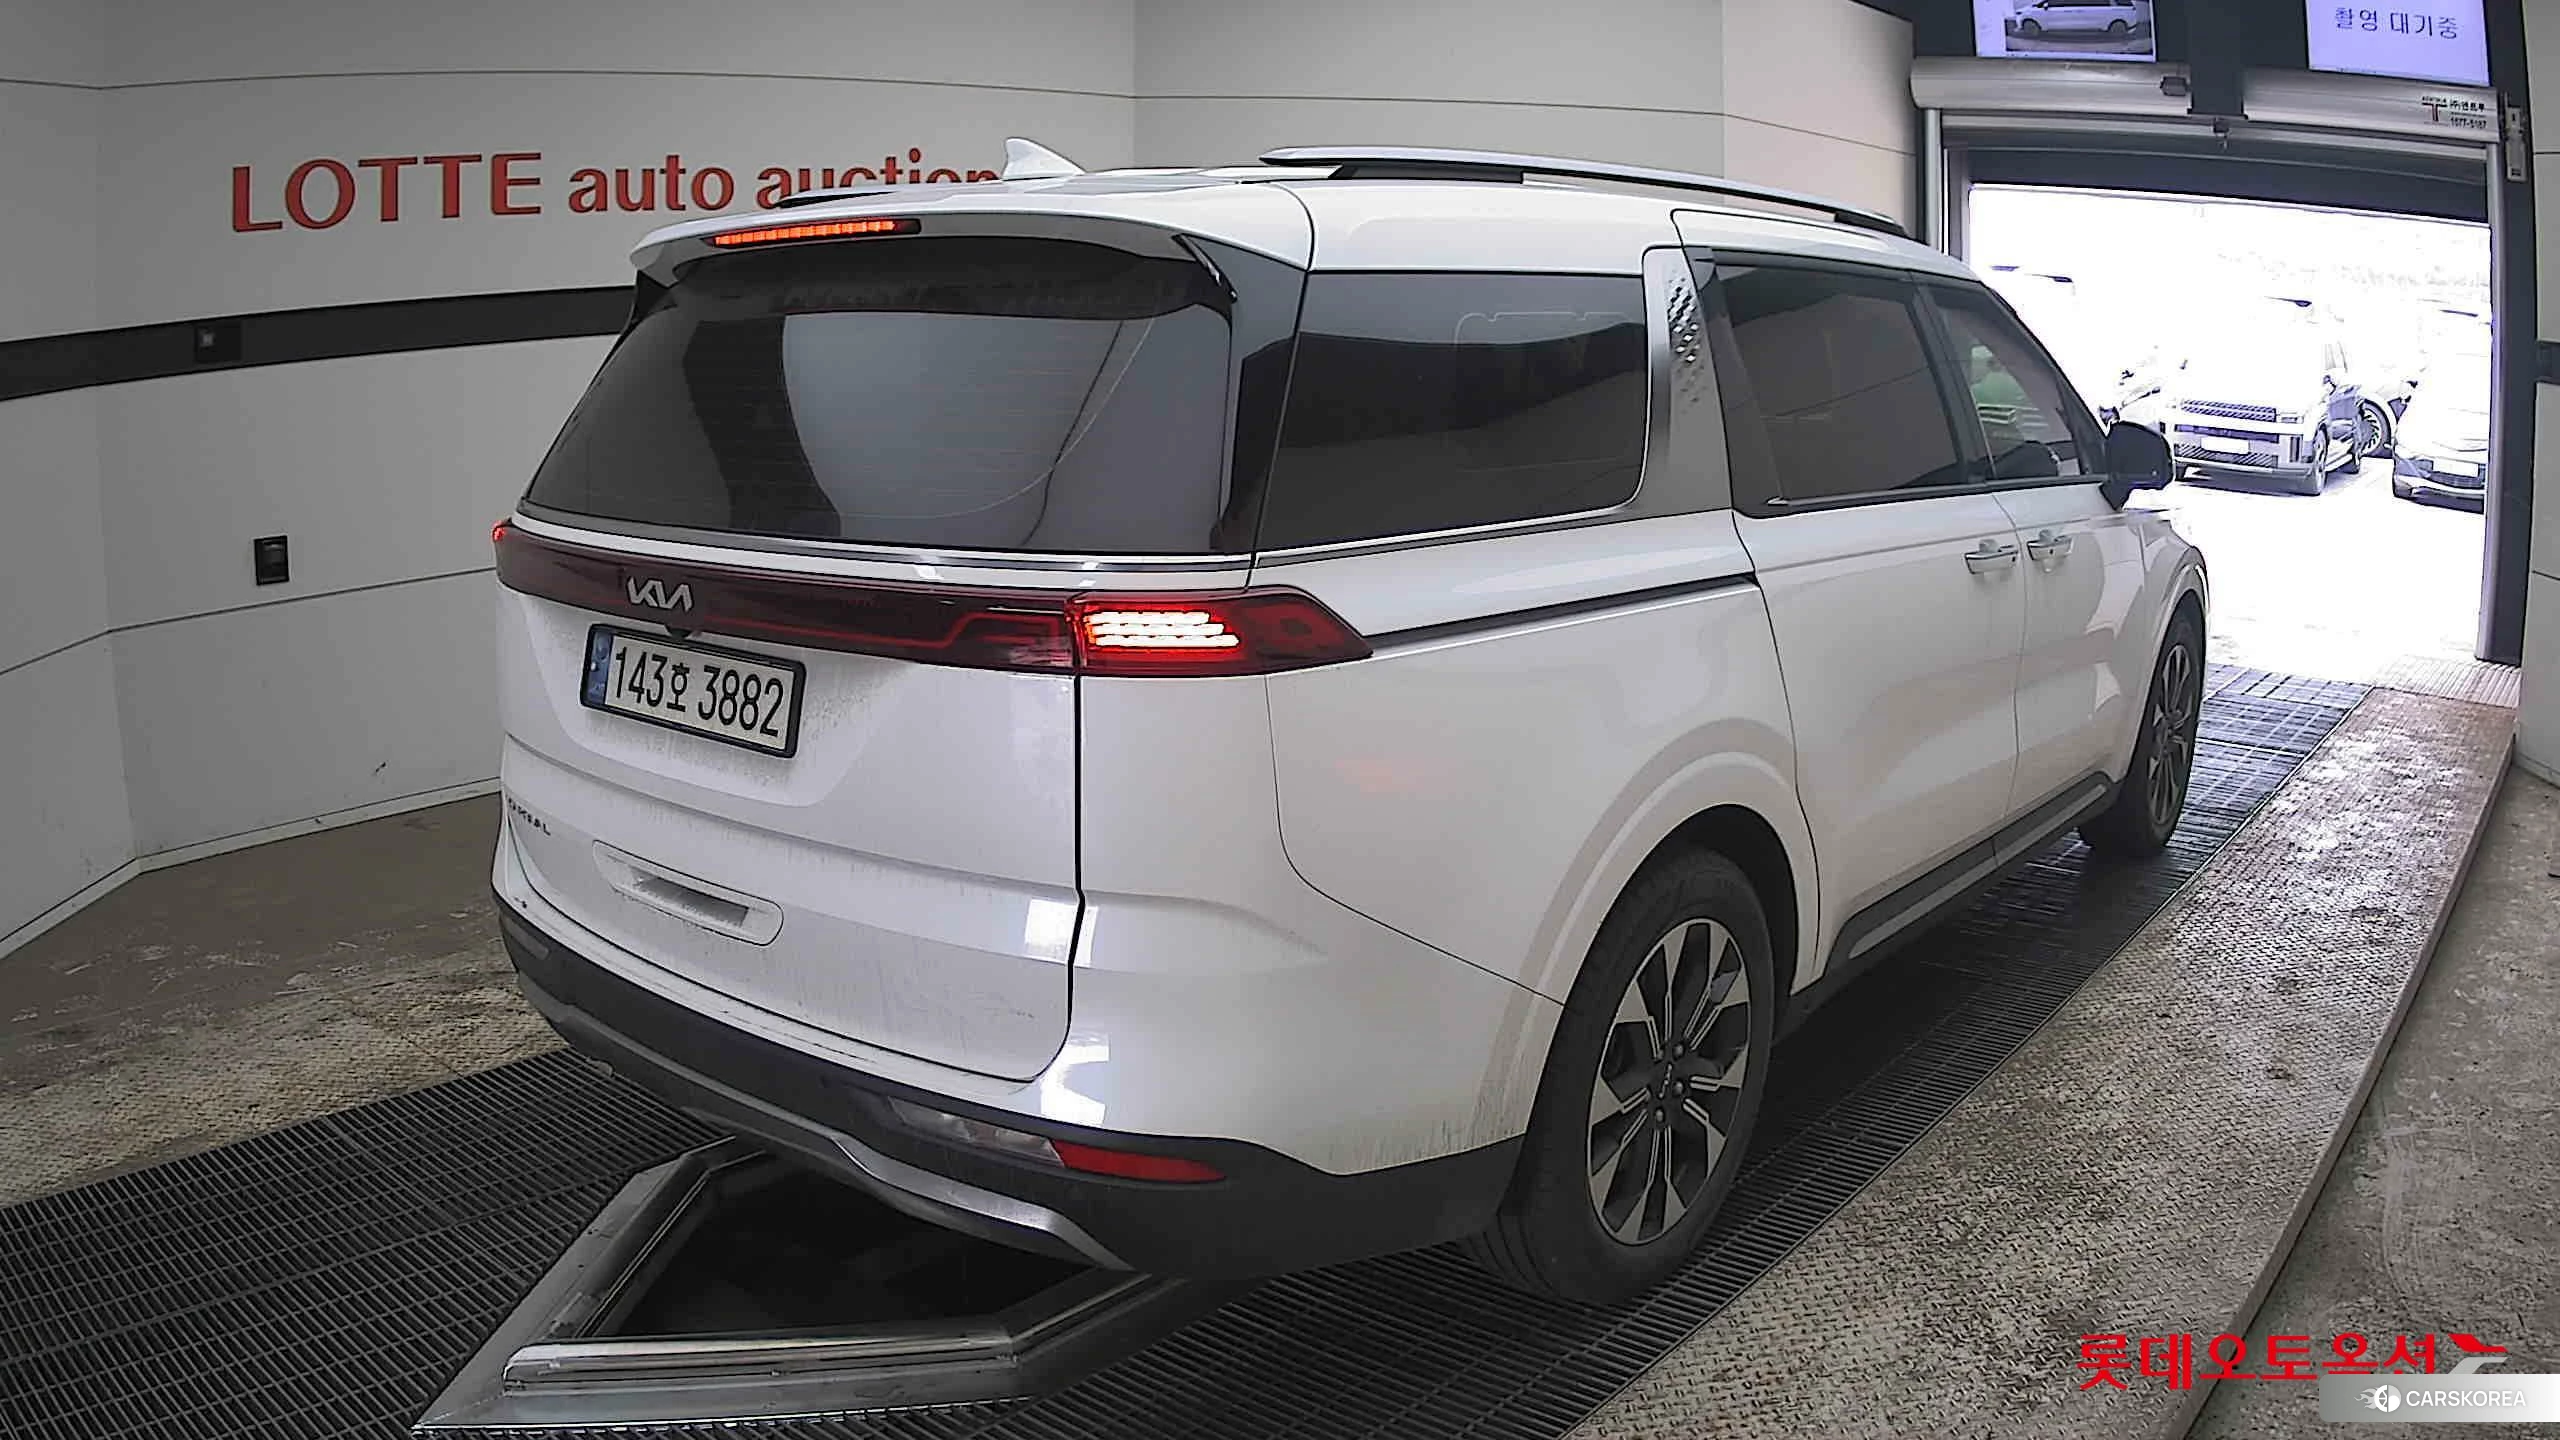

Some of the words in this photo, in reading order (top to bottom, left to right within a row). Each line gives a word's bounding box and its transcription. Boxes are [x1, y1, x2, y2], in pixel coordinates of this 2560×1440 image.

[2335, 7, 2378, 33] 촬영
[2390, 12, 2459, 40] 대기중
[232, 152, 542, 232] LOTTE
[568, 154, 735, 213] auto
[615, 646, 691, 713] 143호
[697, 664, 785, 737] 3882
